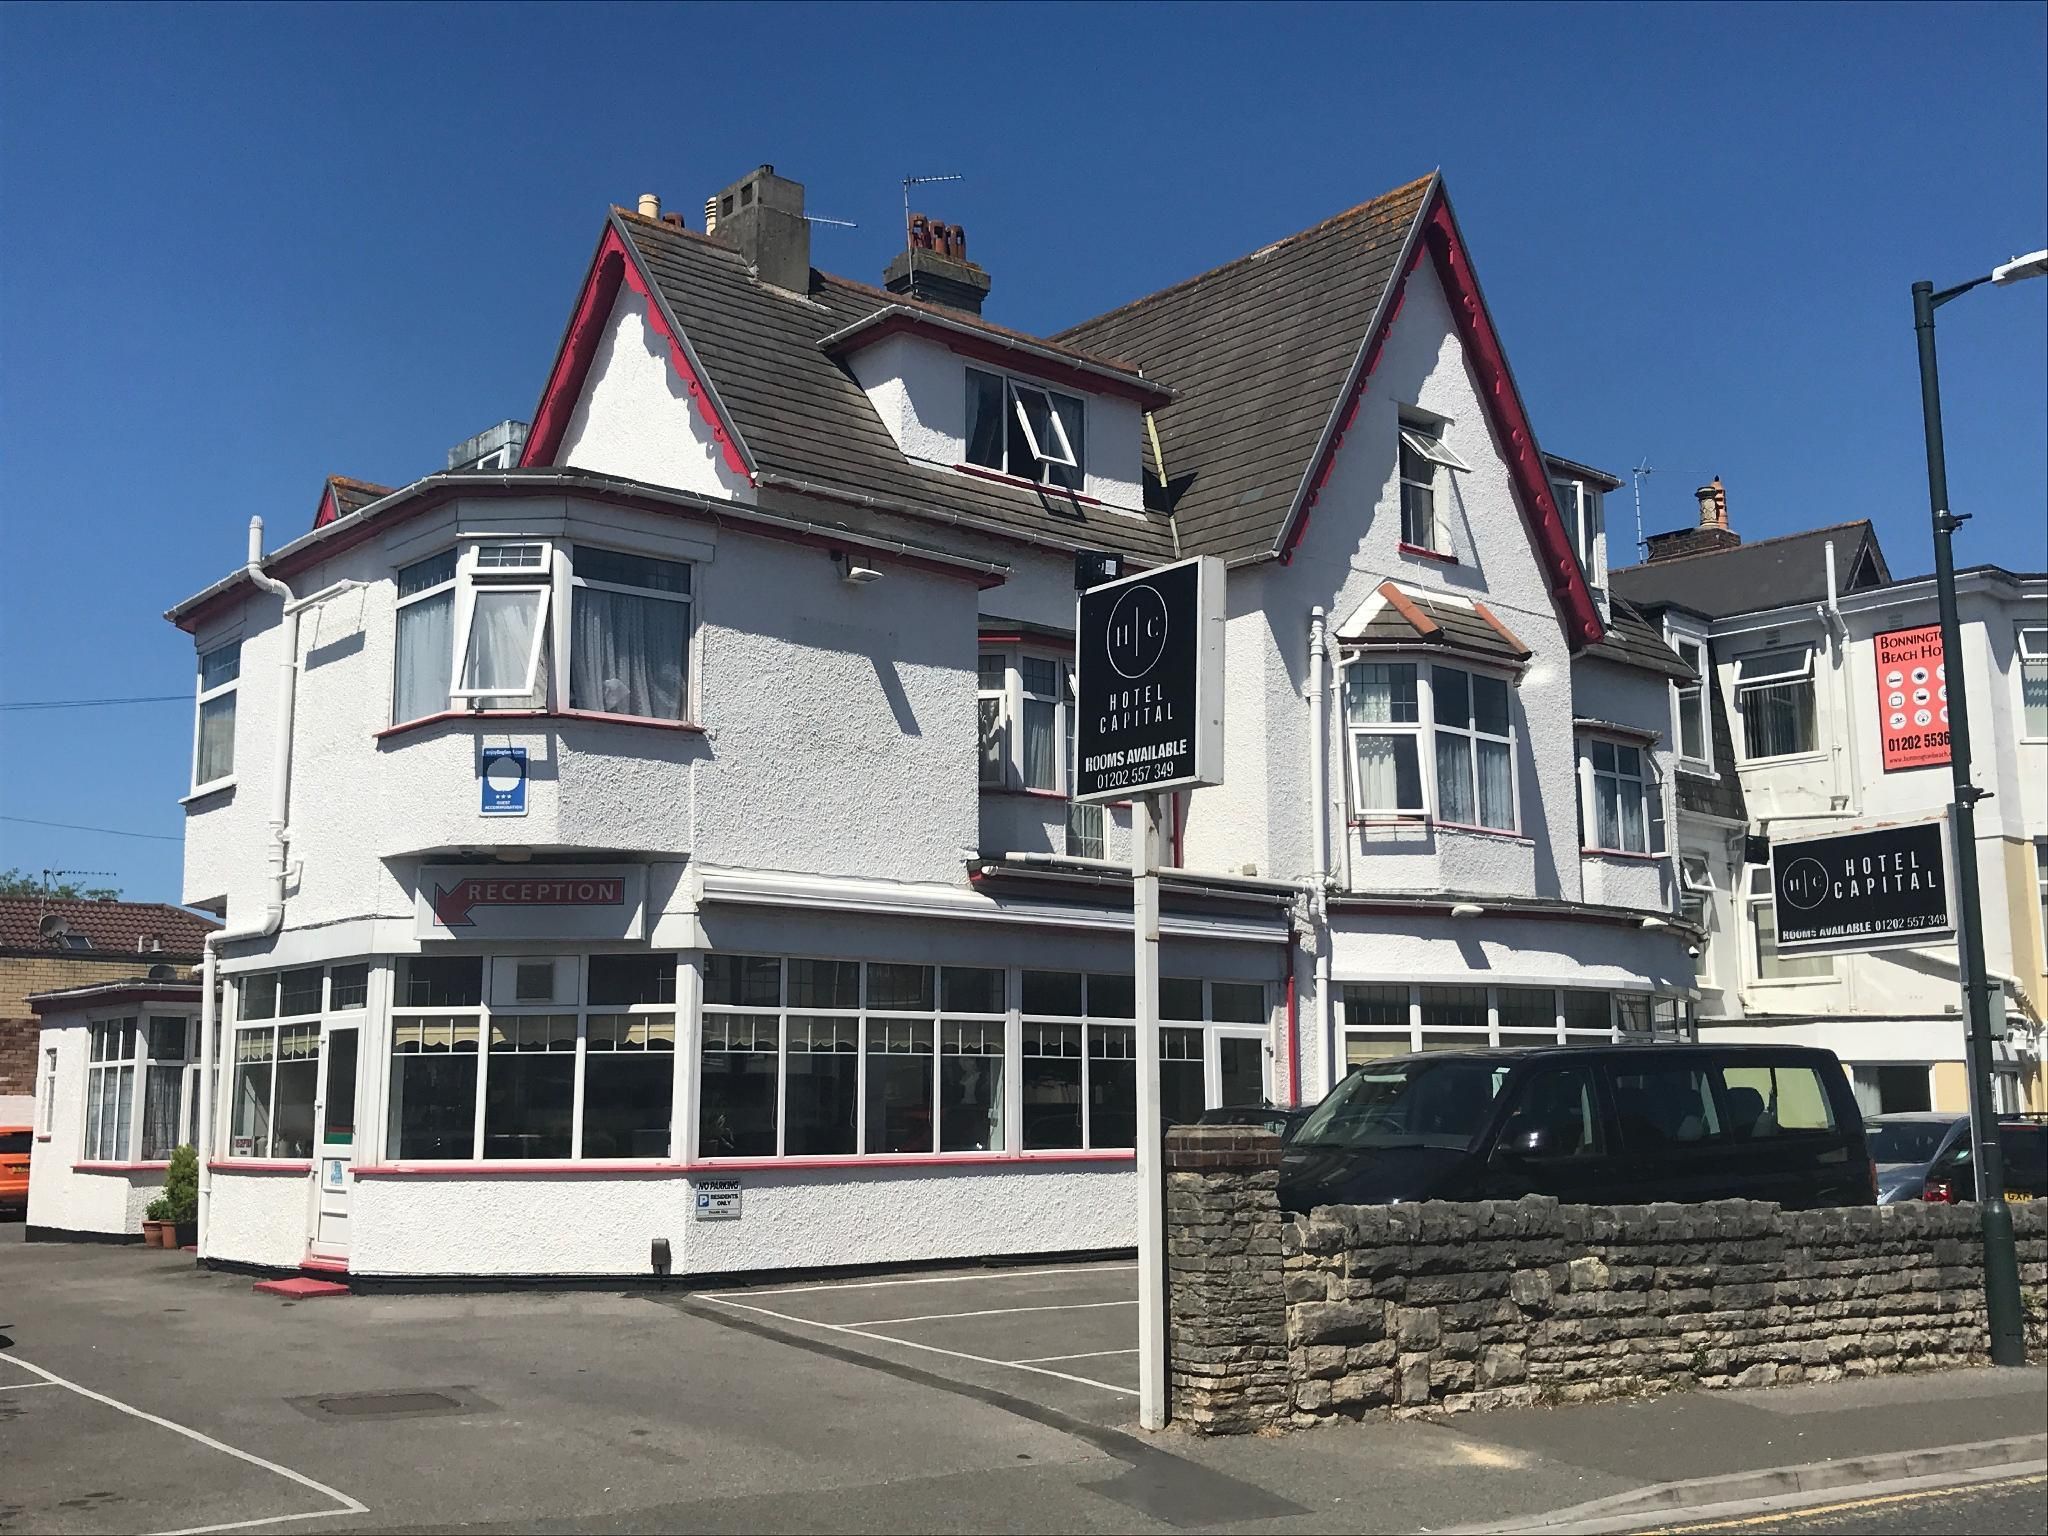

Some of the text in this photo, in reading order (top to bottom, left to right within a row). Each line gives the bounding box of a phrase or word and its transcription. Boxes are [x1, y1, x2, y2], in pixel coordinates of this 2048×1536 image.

[1881, 645, 1944, 664] BEACH HO
[1109, 683, 1163, 712] HOTEL
[1099, 702, 1173, 734] CAPITAL
[1085, 738, 1187, 773] ROOMS AVAILABLE
[1888, 734, 1922, 752] 01202
[1097, 761, 1174, 789] 01202 557 349
[1845, 851, 1920, 877] HOTEL
[468, 883, 614, 900] RECEPTION
[1834, 870, 1936, 899] CAPITAL
[1782, 914, 1946, 940] ROOMS AVAILABLE 01202 557 349
[698, 1180, 739, 1190] NO PARKING
